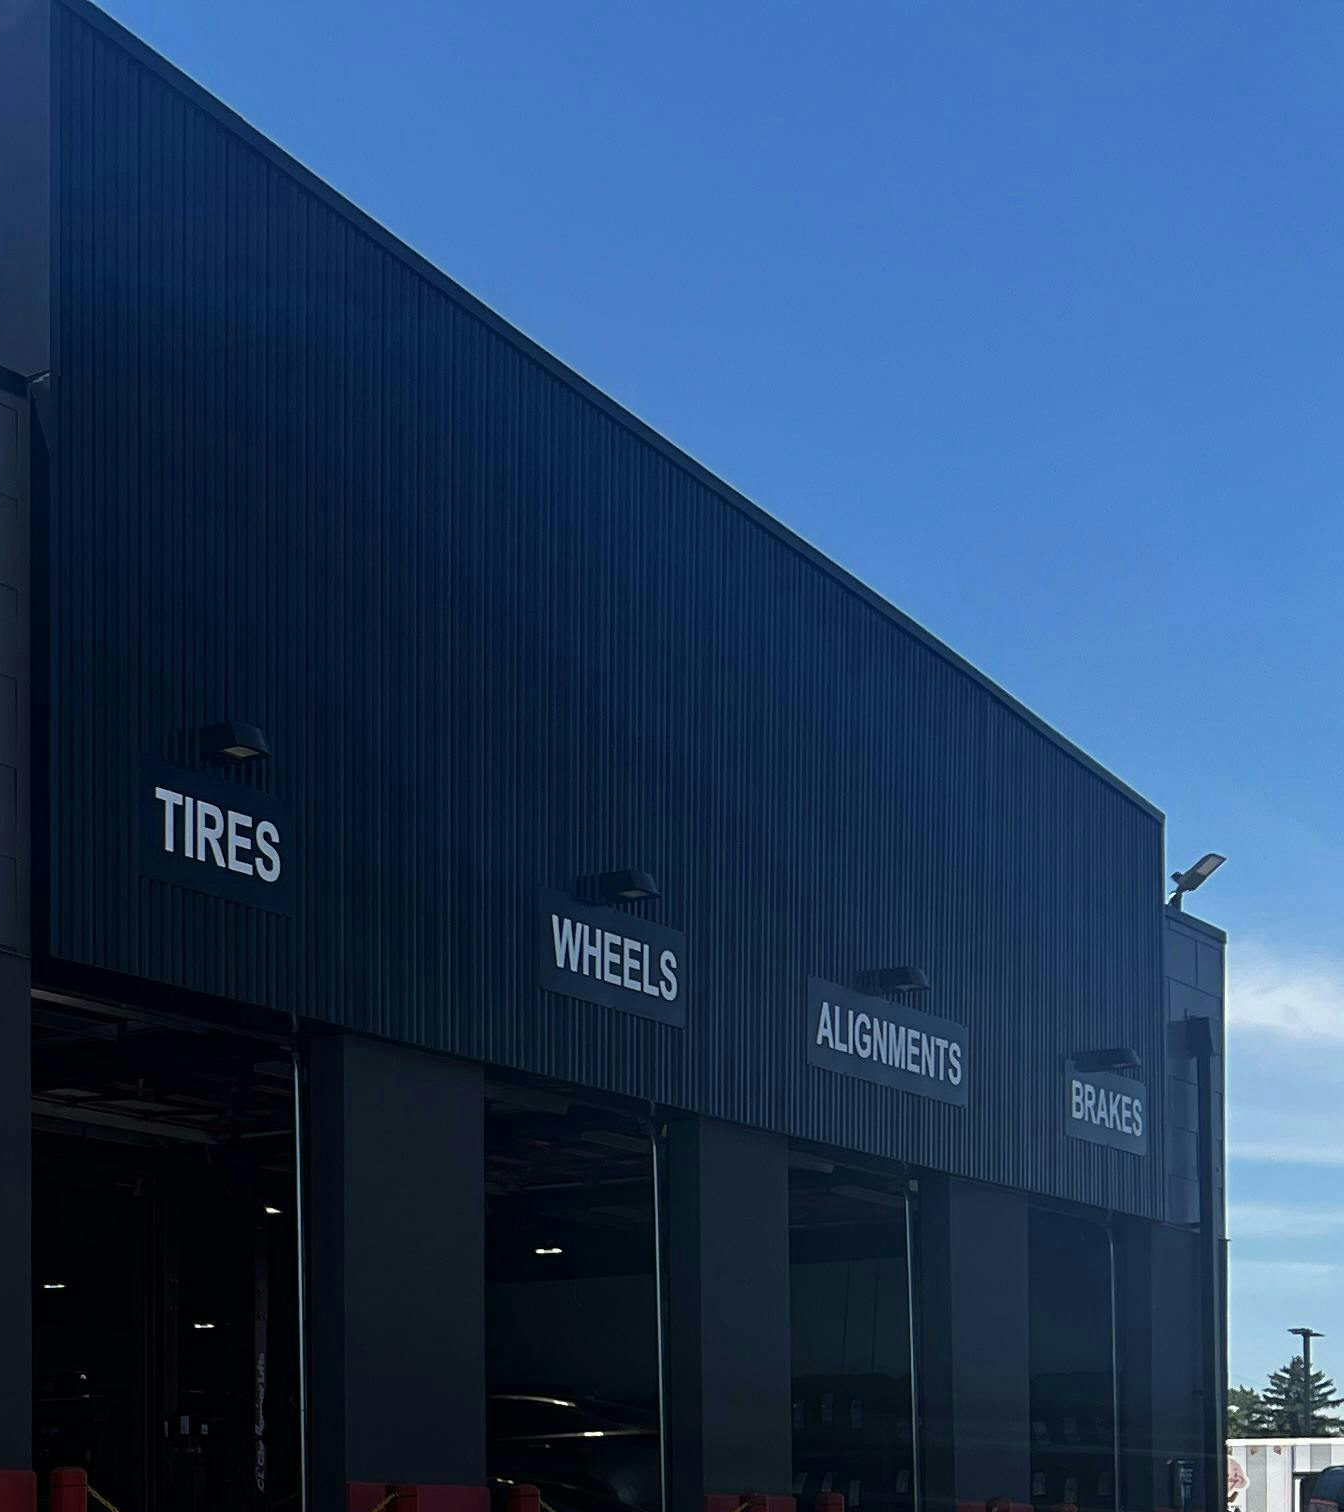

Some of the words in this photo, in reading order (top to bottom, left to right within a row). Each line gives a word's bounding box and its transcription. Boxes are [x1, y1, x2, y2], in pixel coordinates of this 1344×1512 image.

[155, 785, 281, 883] TIRES
[551, 913, 678, 1002] WHEELS
[815, 1001, 962, 1087] ALIGNMENTS
[1071, 1079, 1143, 1137] BRAKES
